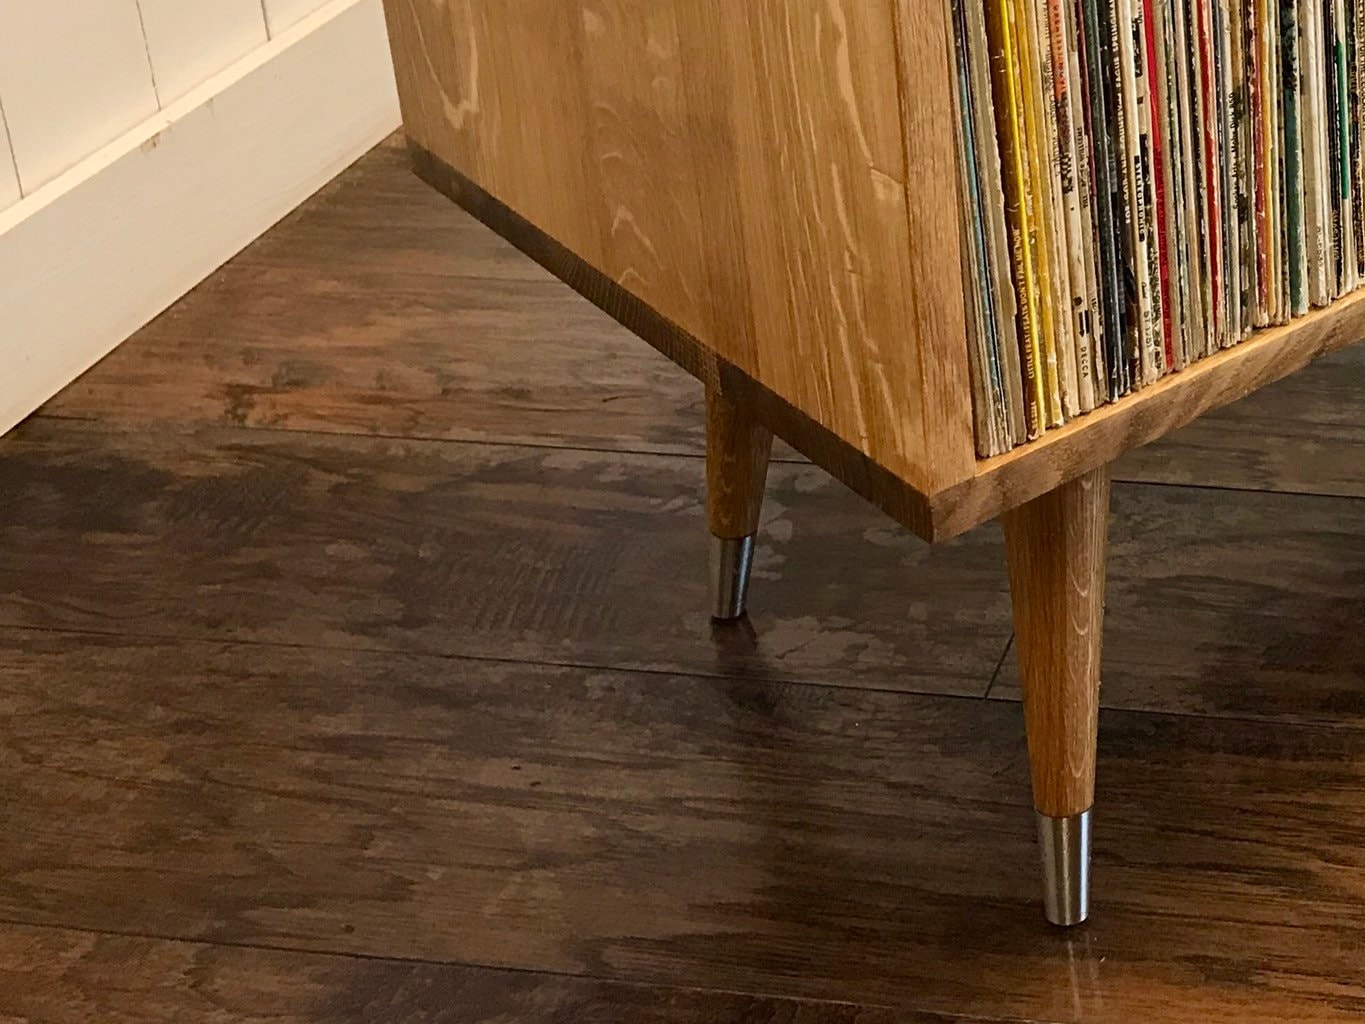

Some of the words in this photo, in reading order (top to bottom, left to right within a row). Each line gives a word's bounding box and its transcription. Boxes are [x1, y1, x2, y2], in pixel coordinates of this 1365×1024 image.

[1017, 278, 1028, 306] DONT
[1025, 351, 1035, 380] LITTLE
[1079, 344, 1089, 379] DECCA
